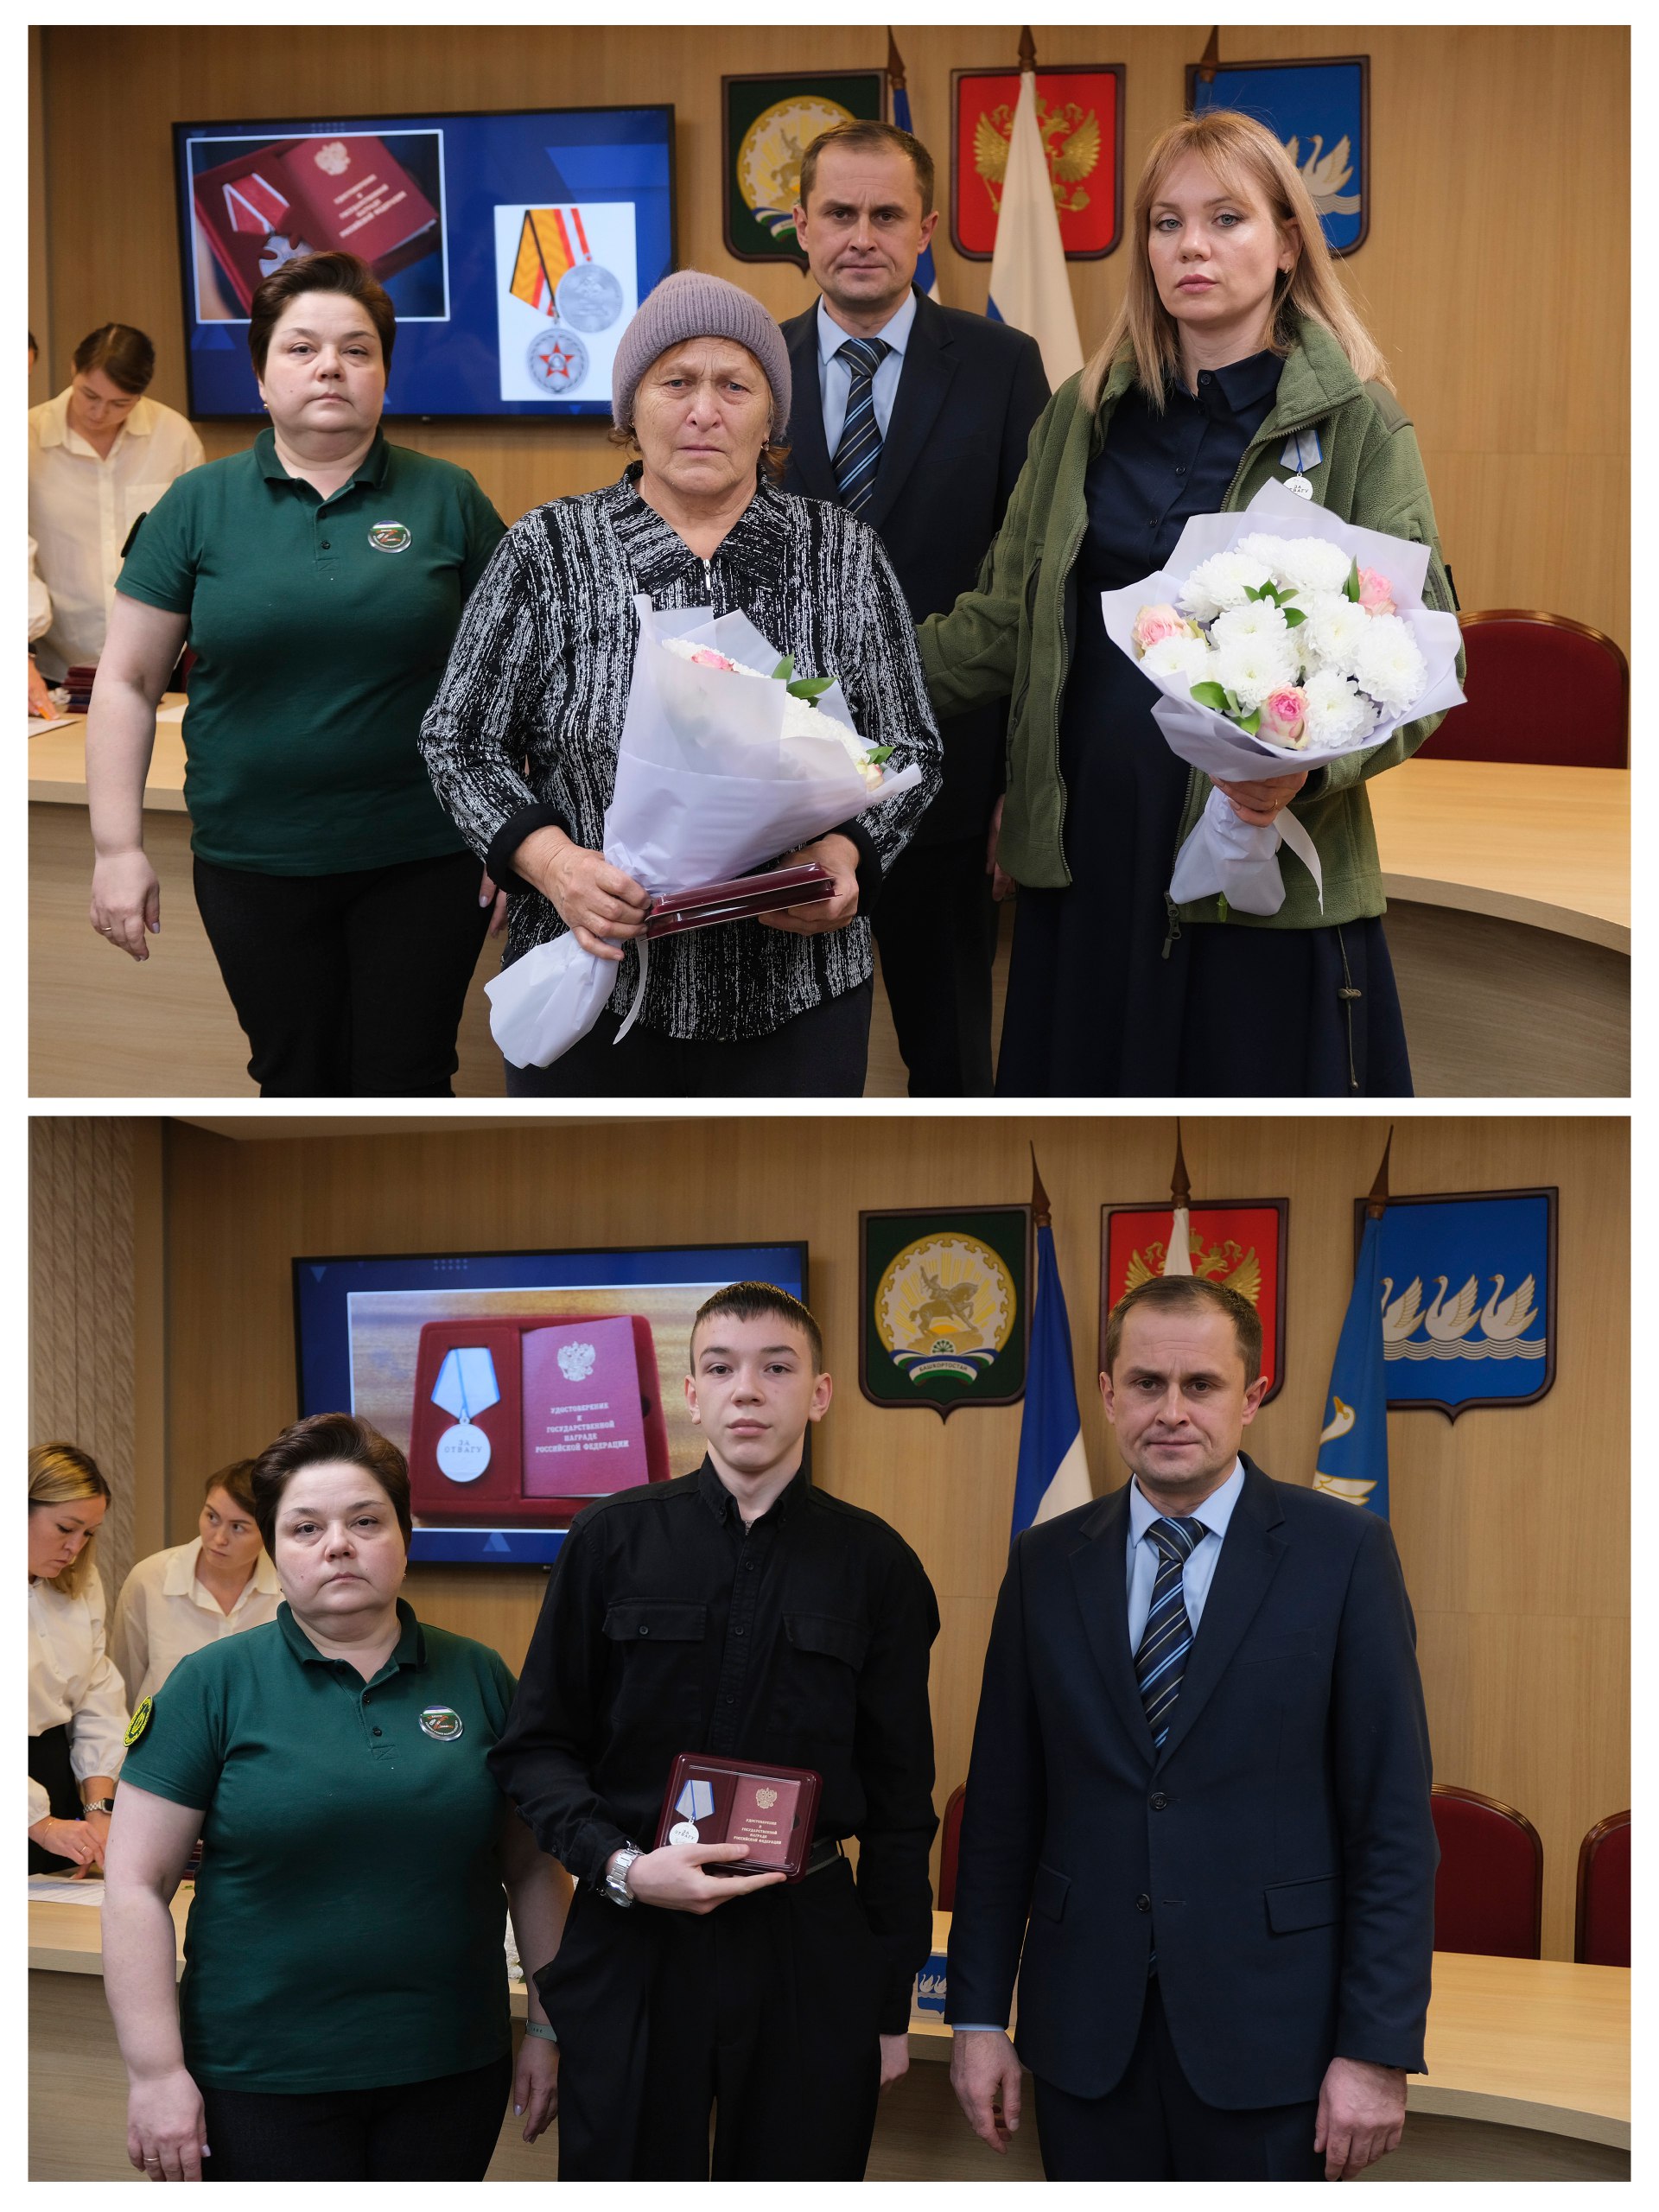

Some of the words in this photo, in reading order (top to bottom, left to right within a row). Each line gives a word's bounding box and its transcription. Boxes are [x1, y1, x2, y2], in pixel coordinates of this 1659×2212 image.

[918, 1362, 968, 1372] БАШКОРТОСТАН
[550, 1402, 609, 1414] УДОСТОВЕРЕНИЕ
[546, 1420, 615, 1433] ГОСУДАРСТВЕННОЙ
[563, 1433, 598, 1442] НАГРАДЕ
[536, 1442, 581, 1453] РОССИЙСКОЙ
[582, 1440, 629, 1451] ФЕДЕРАЦИИ
